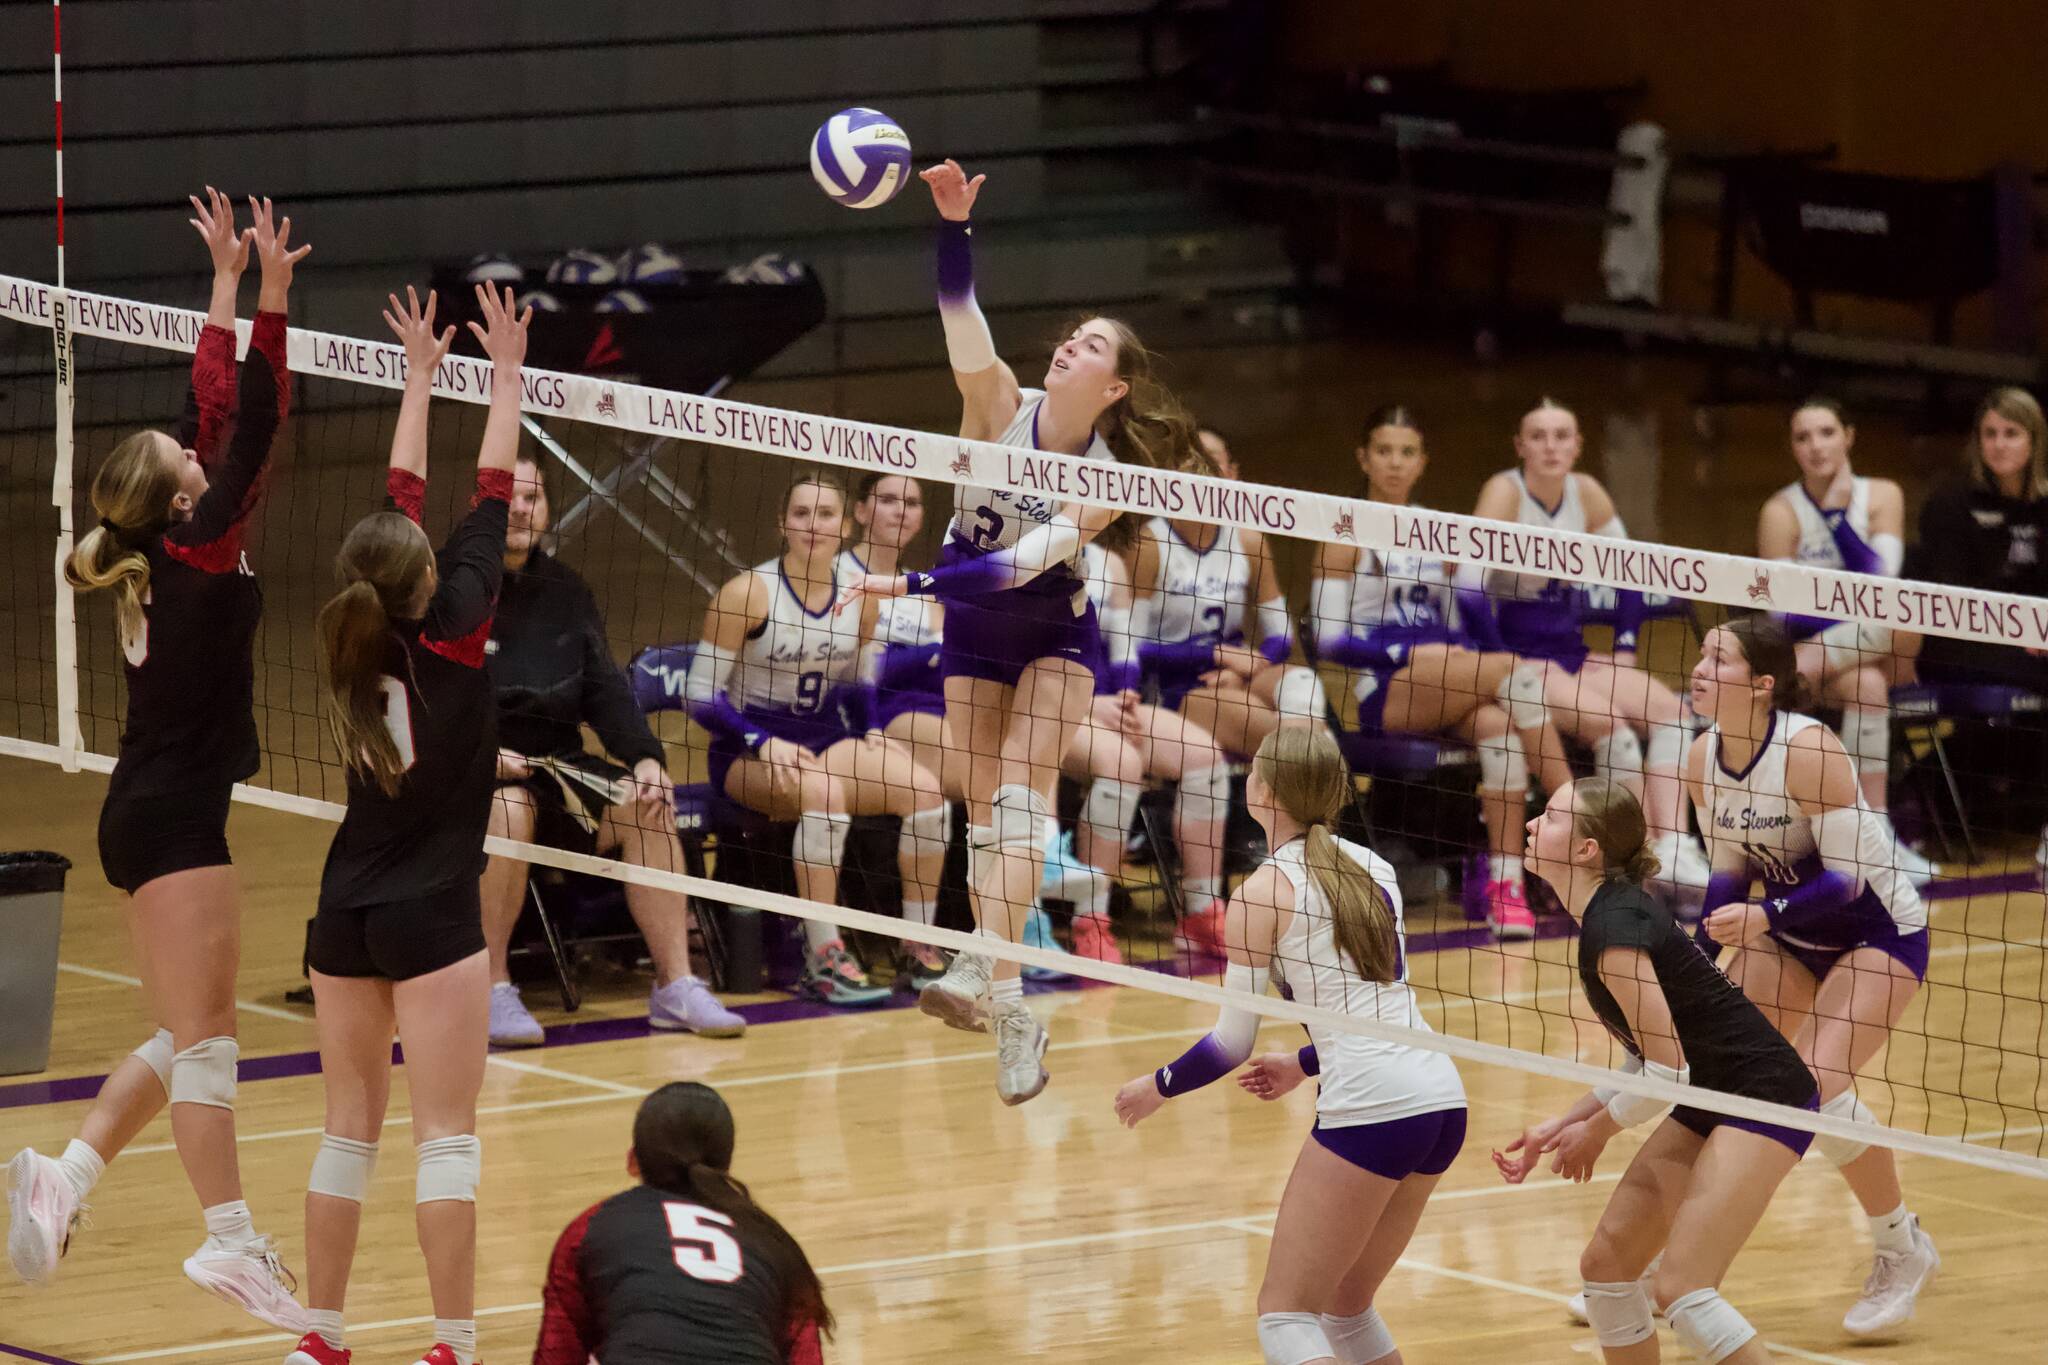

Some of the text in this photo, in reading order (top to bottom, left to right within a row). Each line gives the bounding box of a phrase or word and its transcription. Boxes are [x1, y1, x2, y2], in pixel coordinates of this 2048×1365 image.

[66, 295, 144, 335] TEVENS
[149, 309, 207, 345] VIKIN
[314, 337, 565, 409] LAKE STENS VINGS
[648, 396, 917, 469] LAKE STEVENS VIKINGS
[970, 505, 1004, 551] 2
[1007, 454, 1296, 530] LAKE STEVENS VIKINGS
[1393, 514, 1708, 594] LAKE STEVENS VIKINGS
[1813, 577, 1887, 620] LAKE
[1896, 589, 2023, 639] STEVENS
[793, 671, 824, 714] 9
[661, 1200, 745, 1283] 5
